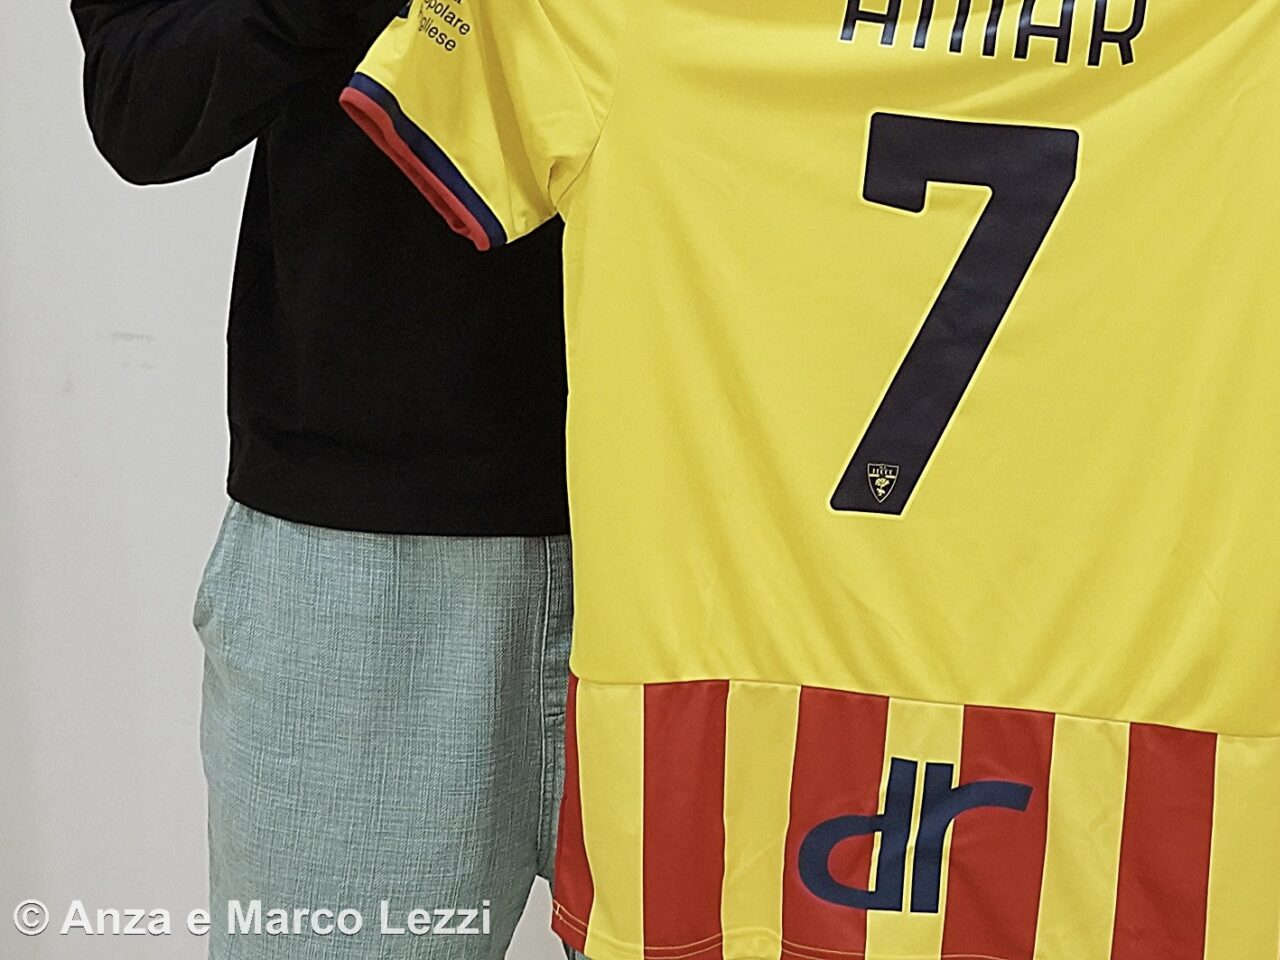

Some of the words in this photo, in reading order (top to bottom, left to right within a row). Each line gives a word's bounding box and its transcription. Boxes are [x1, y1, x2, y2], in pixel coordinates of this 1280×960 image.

[418, 10, 457, 52] gliese
[829, 111, 1080, 516] 7
[797, 756, 1034, 914] dr
